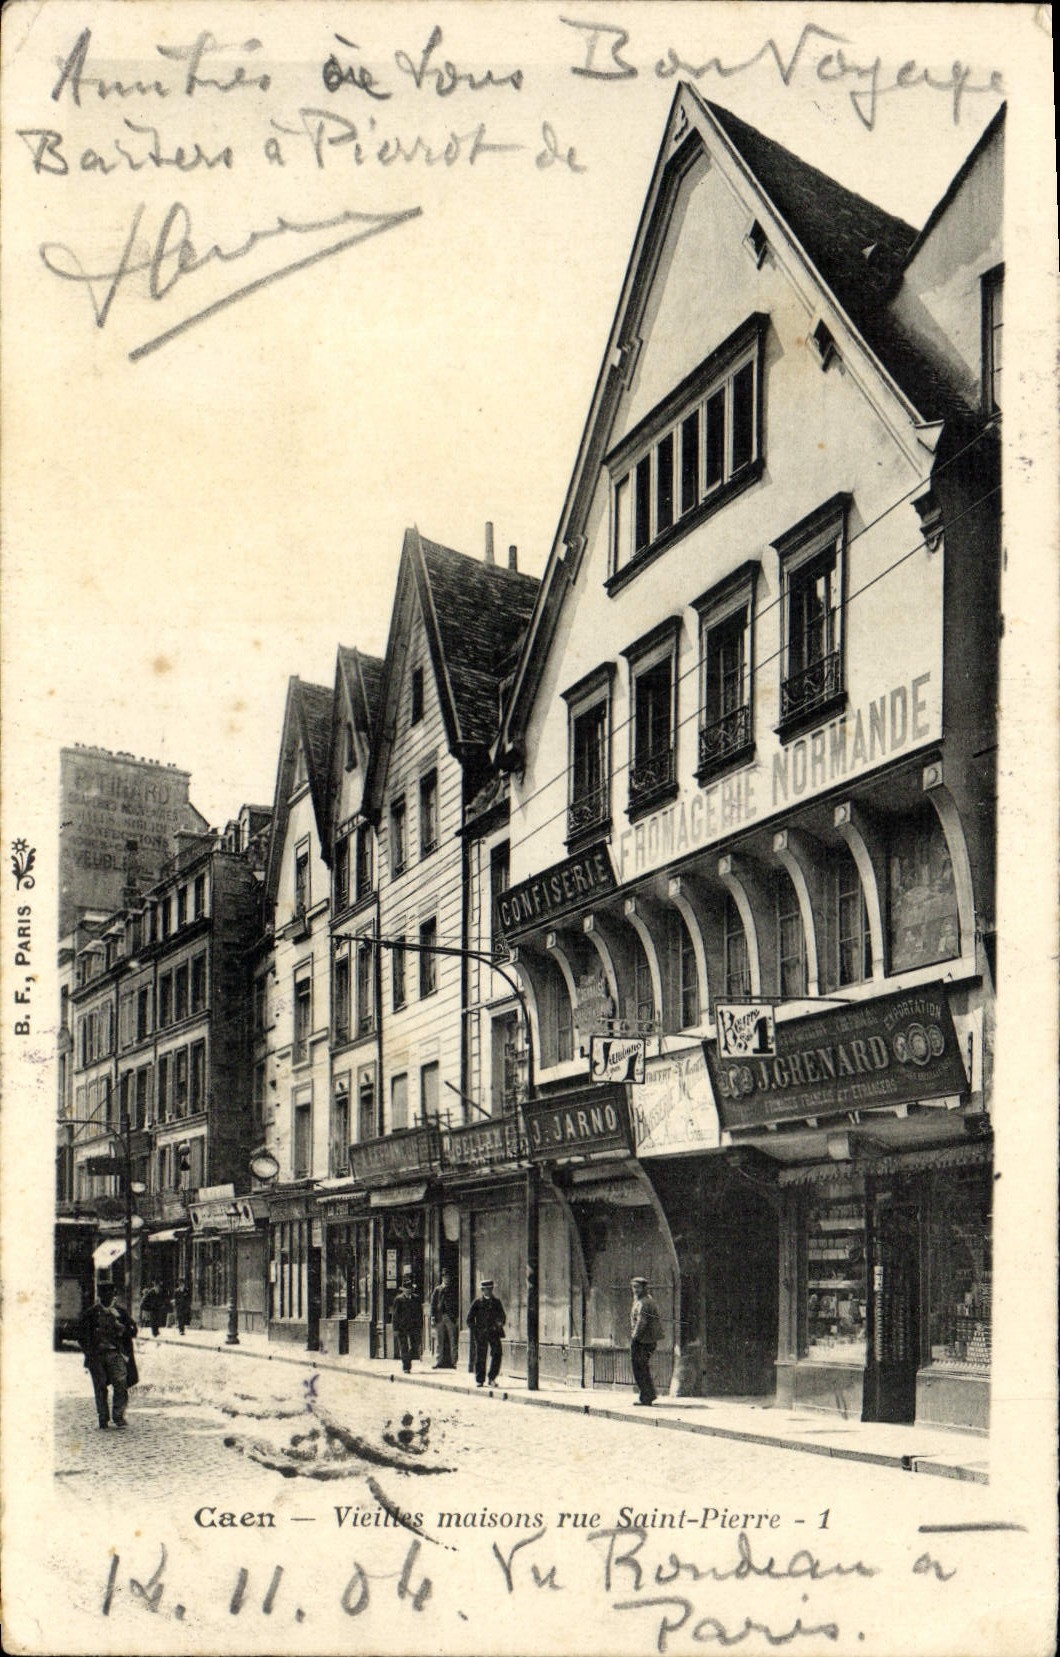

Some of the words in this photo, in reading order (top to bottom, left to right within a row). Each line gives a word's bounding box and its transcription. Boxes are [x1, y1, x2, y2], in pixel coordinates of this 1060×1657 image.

[534, 121, 587, 173] de
[772, 671, 932, 806] NORMANDE
[500, 853, 611, 925] CONFISERIE
[553, 1104, 618, 1141] JARNO
